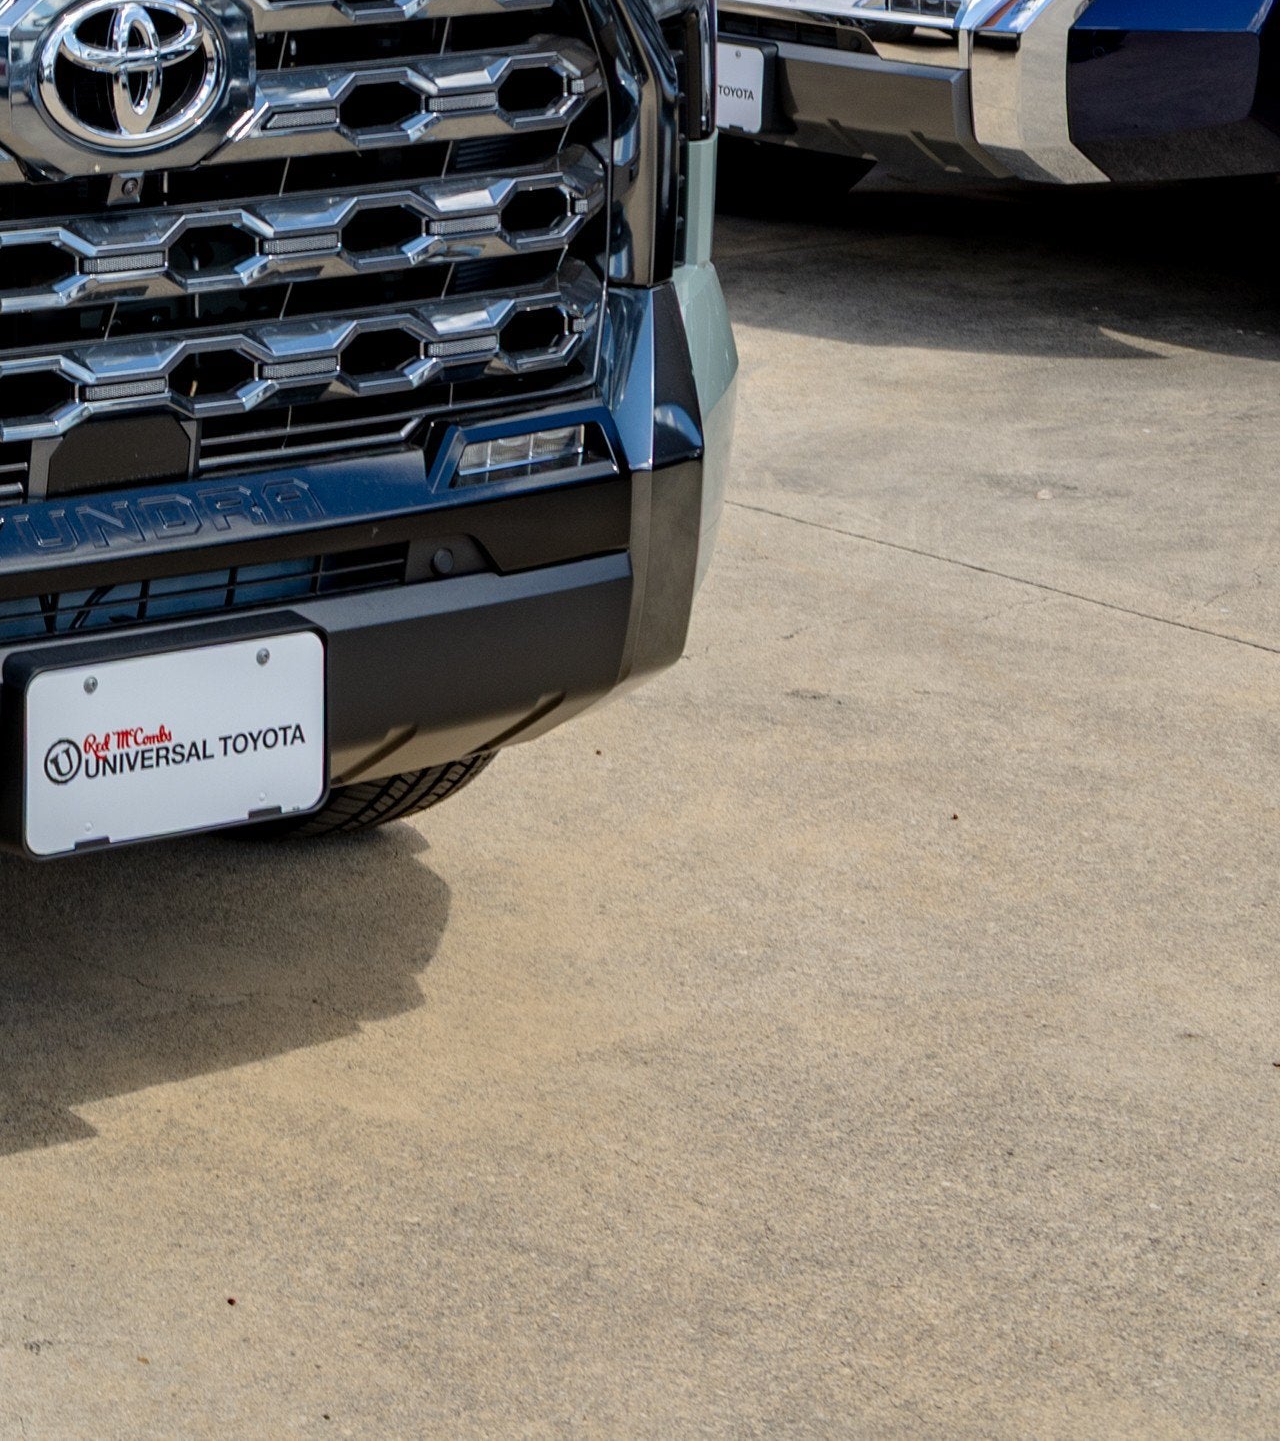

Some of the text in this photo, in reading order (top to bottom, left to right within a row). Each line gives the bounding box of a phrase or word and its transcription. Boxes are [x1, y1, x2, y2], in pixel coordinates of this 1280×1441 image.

[718, 84, 755, 101] TOYOTA
[84, 733, 111, 759] Red
[85, 724, 305, 778] UNIVERSAL TOYOTA
